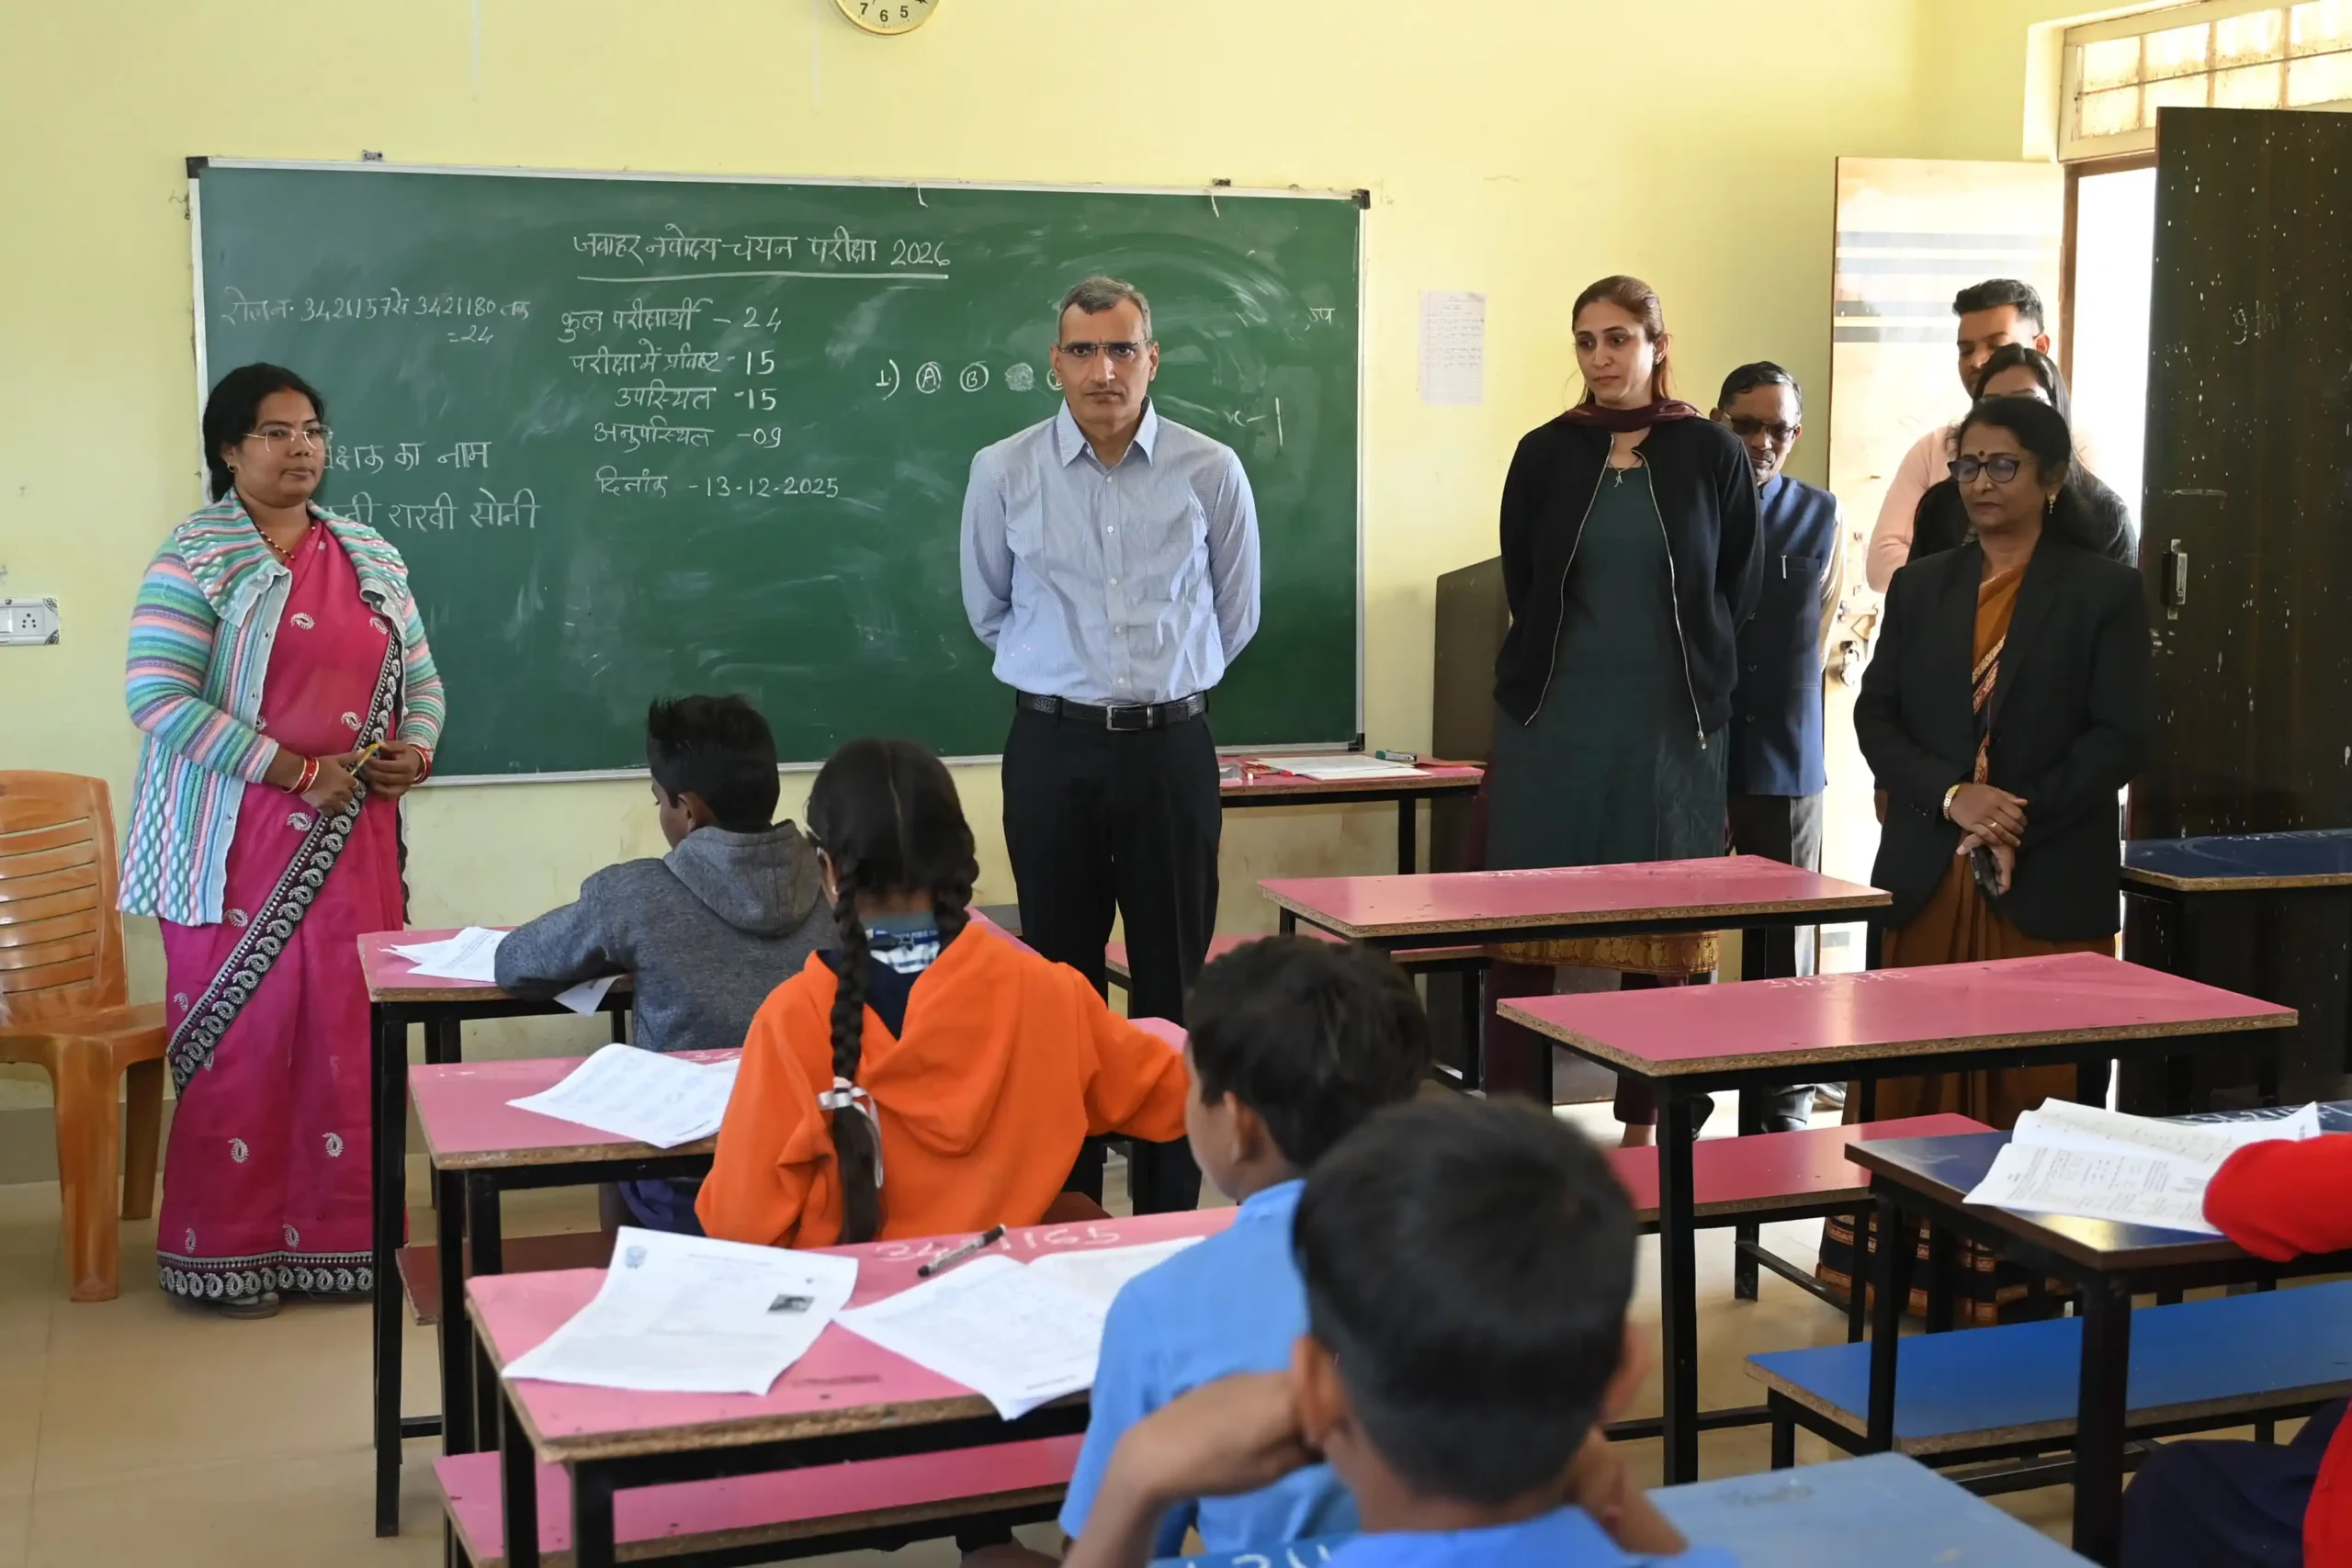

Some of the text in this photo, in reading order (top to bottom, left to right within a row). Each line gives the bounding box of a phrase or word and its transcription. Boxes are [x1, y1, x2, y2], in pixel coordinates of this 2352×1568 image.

[859, 2, 868, 16] 7
[879, 9, 888, 22] 6
[899, 6, 909, 18] 5
[573, 232, 644, 266] जवाहर
[807, 225, 876, 264] परीक्षा
[890, 239, 951, 266] 2026
[413, 296, 496, 317] 3421180
[557, 310, 604, 343] कुल
[613, 297, 714, 331] परीक्षार्थी
[743, 306, 782, 333] 24
[570, 345, 641, 376] परीक्षा
[394, 441, 426, 471] का
[436, 441, 492, 468] नाम
[595, 465, 668, 499] दिनांक
[876, 1225, 1121, 1262] 341165
